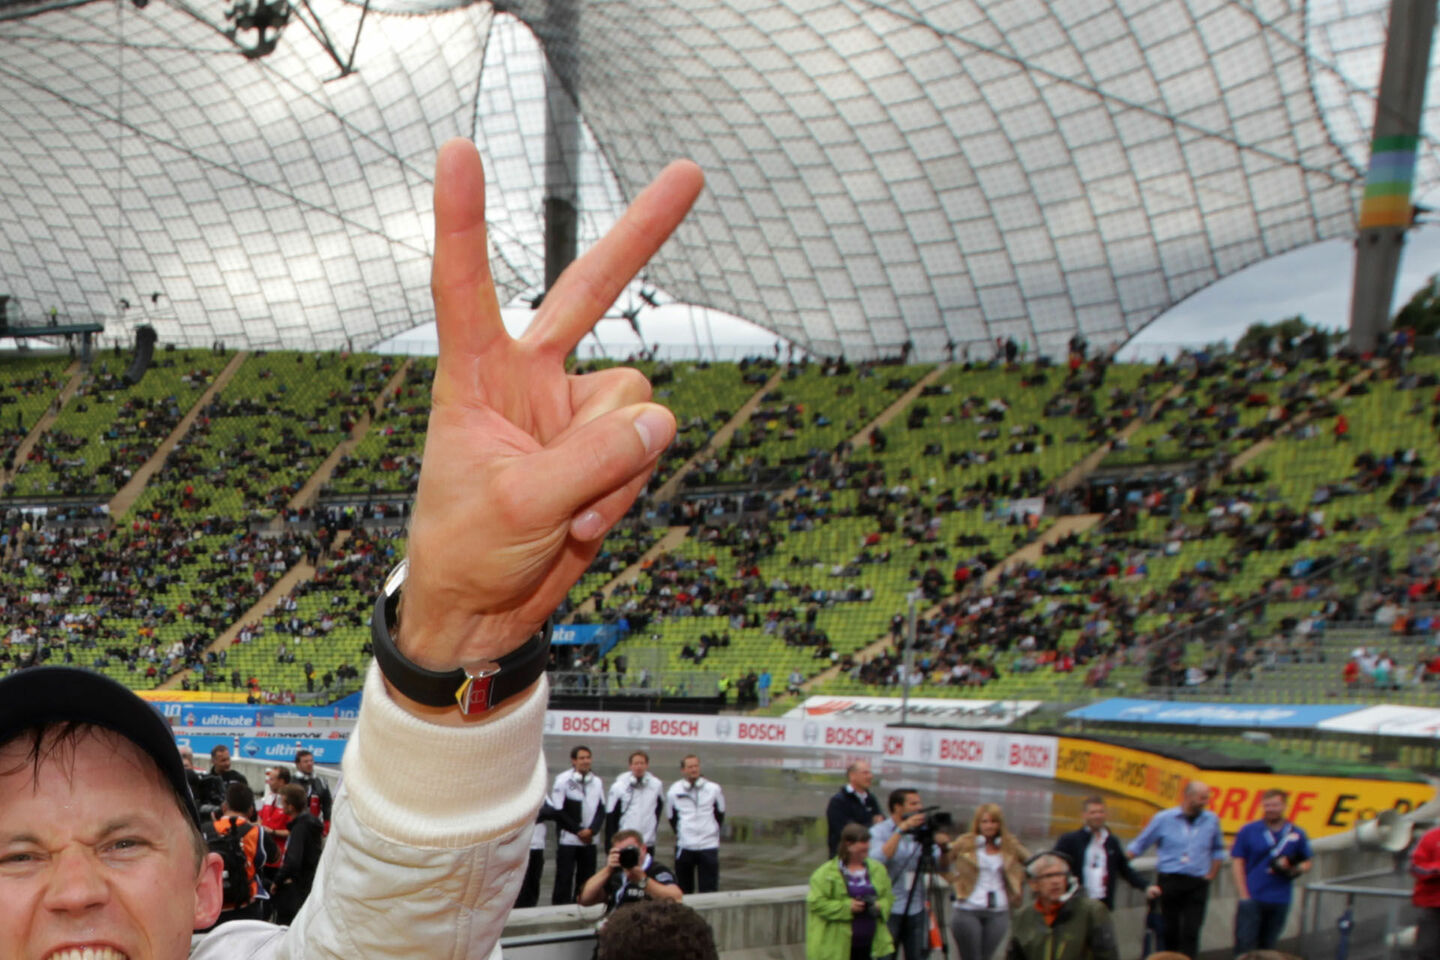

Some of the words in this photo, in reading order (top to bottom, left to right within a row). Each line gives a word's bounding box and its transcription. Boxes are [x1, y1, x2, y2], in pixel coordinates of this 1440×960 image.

[202, 714, 254, 726] ultimate
[562, 716, 610, 732] BOSCH
[650, 719, 699, 736] BOSCH
[738, 723, 786, 741] BOSCH
[825, 727, 874, 746] BOSCH
[940, 738, 985, 761] BOSCH
[1009, 743, 1051, 768] BOSCH
